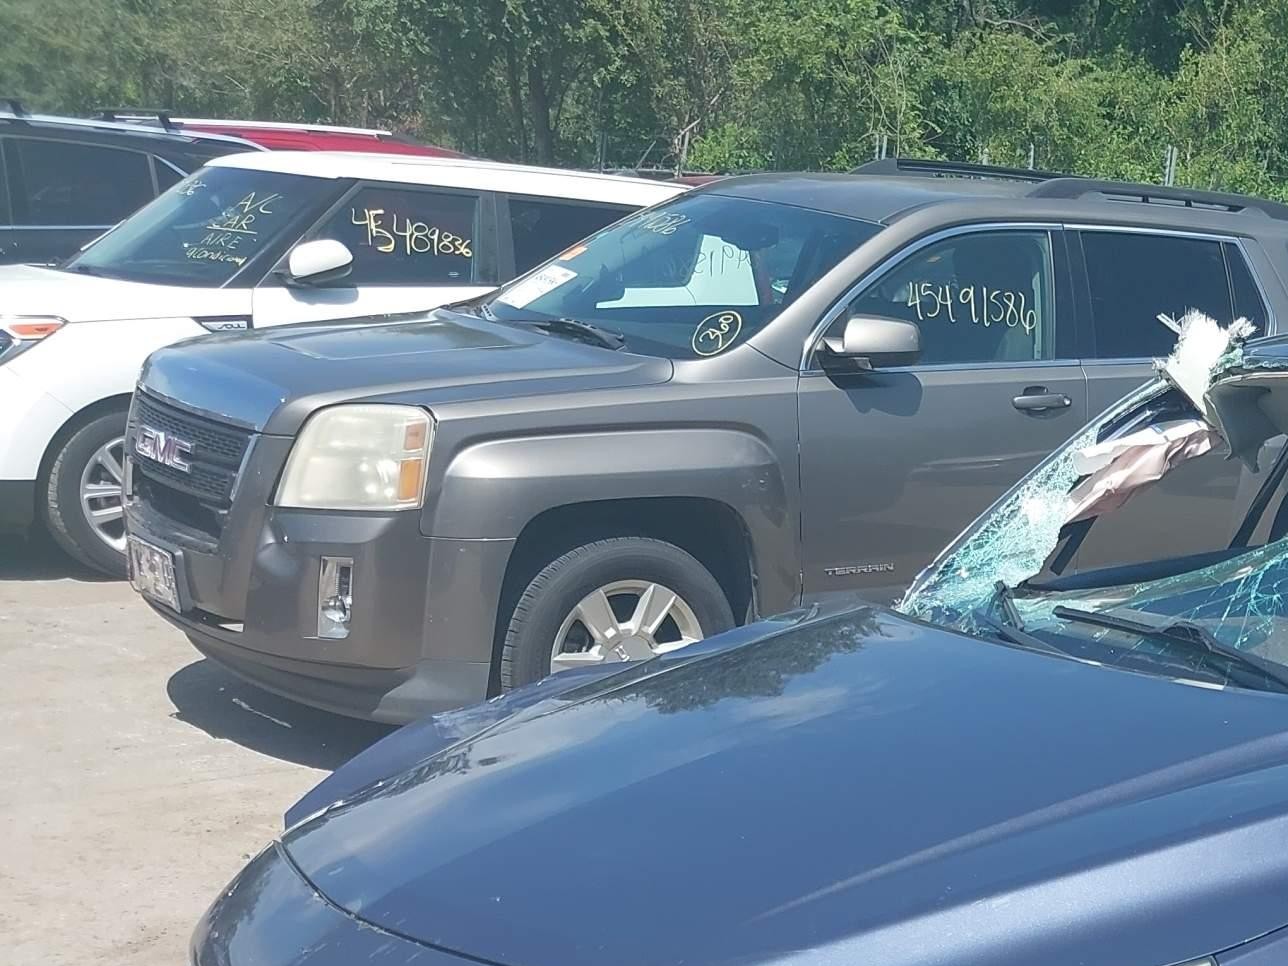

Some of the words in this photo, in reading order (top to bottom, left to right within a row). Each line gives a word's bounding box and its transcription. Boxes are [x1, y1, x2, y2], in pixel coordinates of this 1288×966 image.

[907, 281, 1037, 335] 45491586
[136, 424, 193, 474] GMC
[823, 563, 895, 576] TERRAIN
